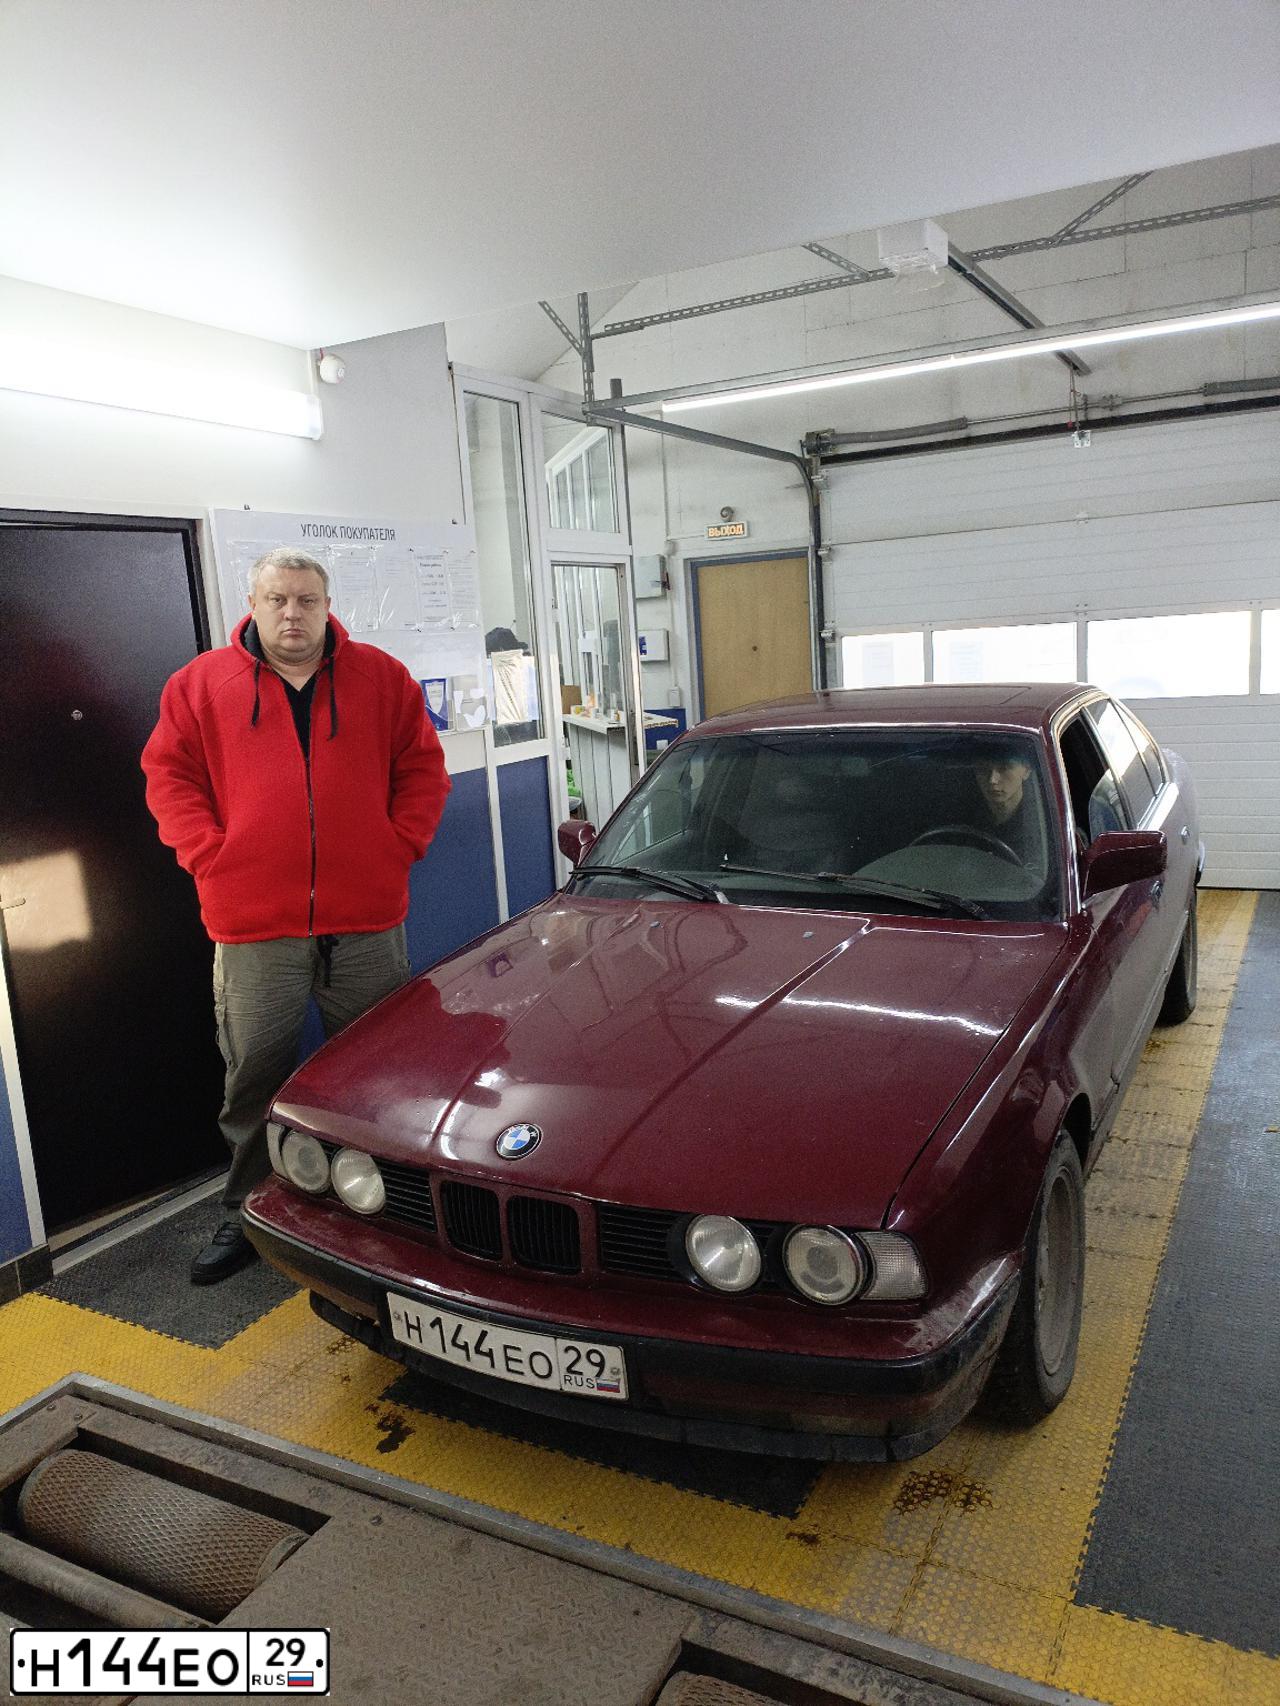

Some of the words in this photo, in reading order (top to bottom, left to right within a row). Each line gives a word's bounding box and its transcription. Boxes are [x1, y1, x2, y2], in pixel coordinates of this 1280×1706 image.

[300, 523, 338, 539] УГОЛОК
[340, 525, 395, 541] ПОКУПАТЕЛЯ
[708, 524, 744, 537] ВЫХОД
[564, 1345, 606, 1378] 29
[564, 1374, 595, 1389] RUS
